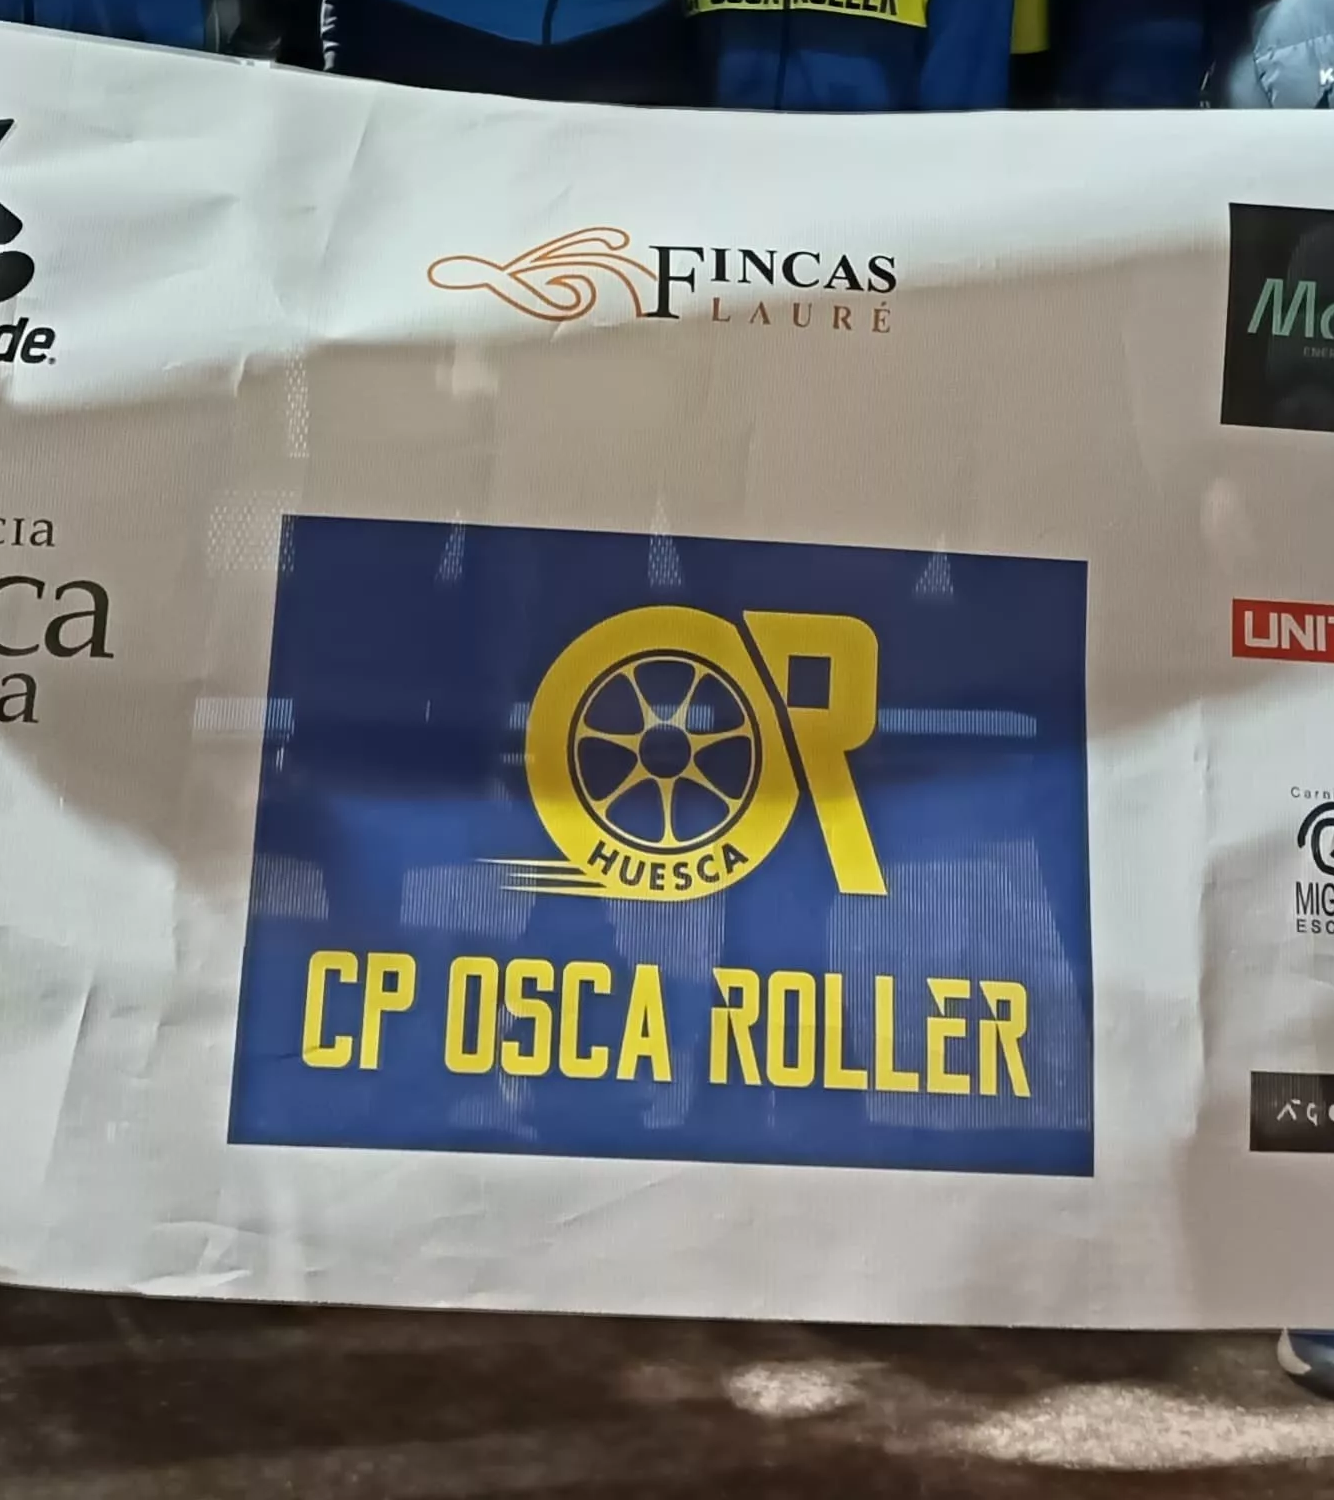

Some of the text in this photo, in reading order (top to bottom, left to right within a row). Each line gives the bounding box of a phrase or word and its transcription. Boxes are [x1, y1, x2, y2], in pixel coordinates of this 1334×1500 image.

[647, 245, 897, 320] FINCAS
[710, 296, 893, 334] LAURÉ
[587, 841, 749, 892] HUESCA
[301, 950, 1031, 1098] CP OSCA ROLLER
